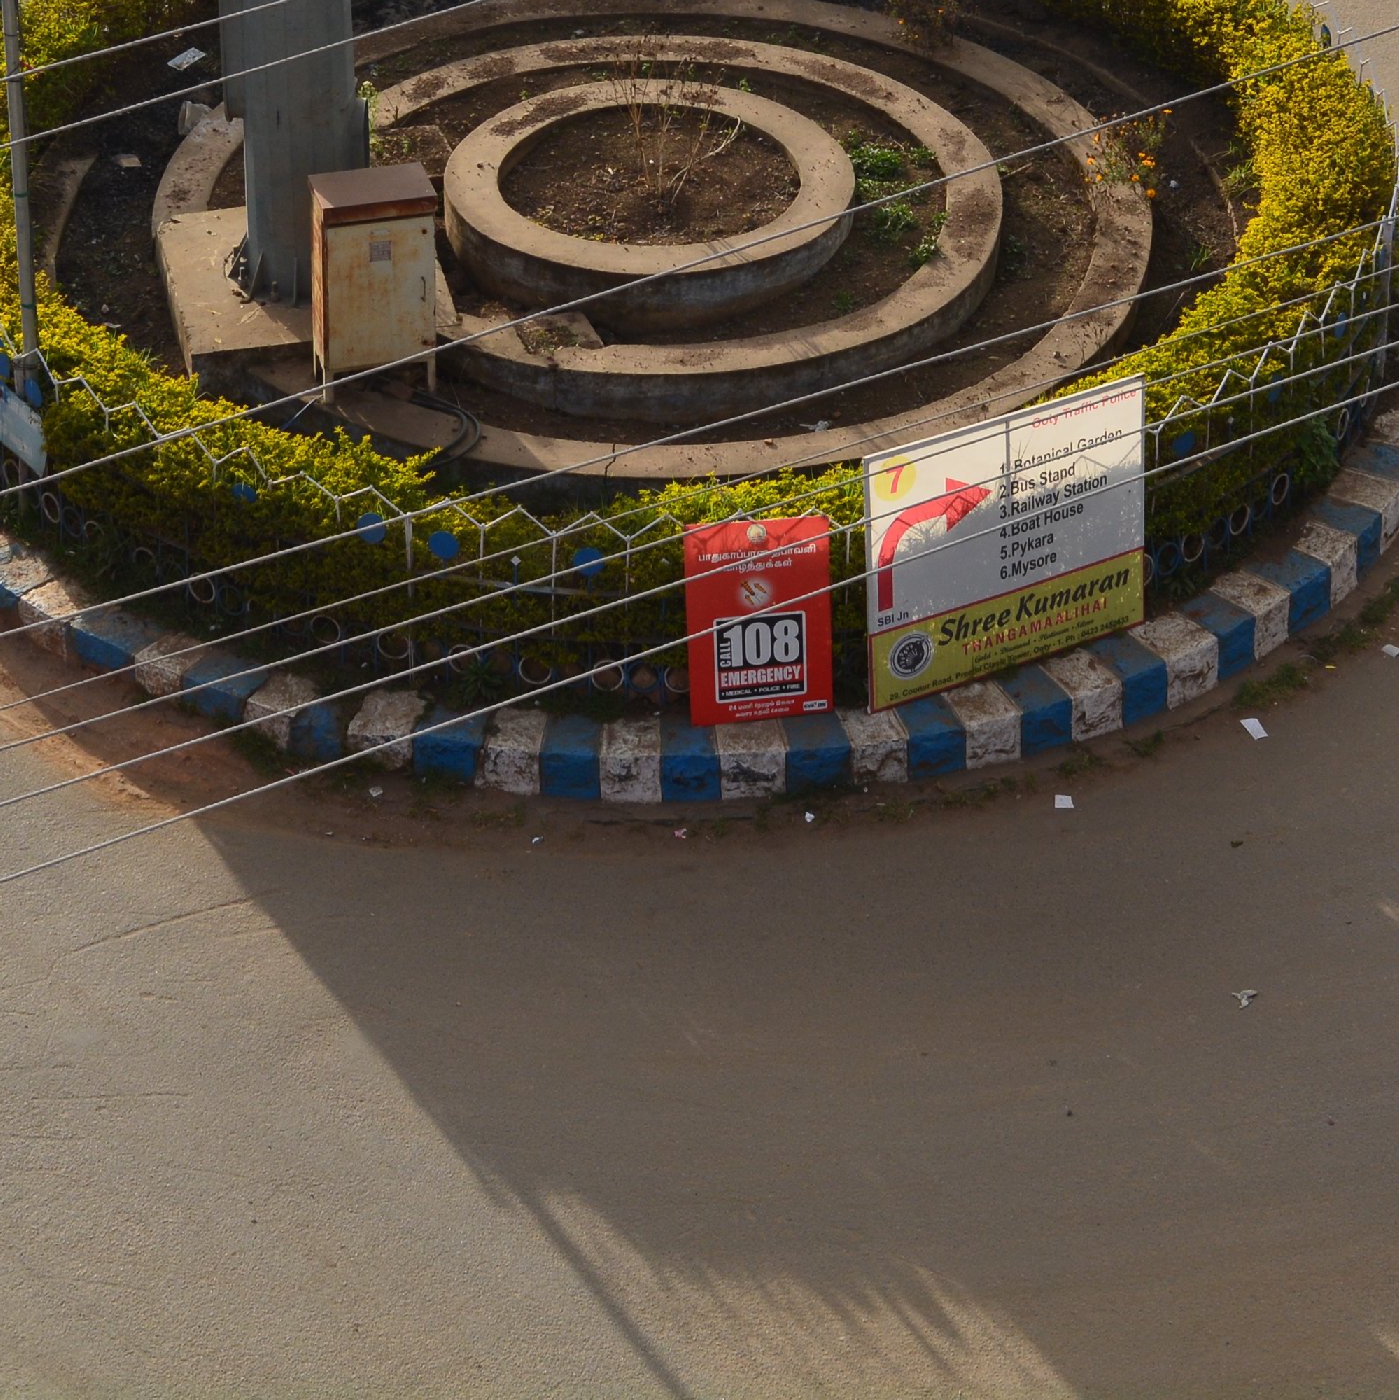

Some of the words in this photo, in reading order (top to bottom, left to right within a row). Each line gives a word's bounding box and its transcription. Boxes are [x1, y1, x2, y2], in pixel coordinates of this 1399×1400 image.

[1063, 401, 1098, 419] Traffic
[1102, 389, 1137, 407] Police
[1077, 429, 1123, 451] Garden
[886, 465, 904, 494] 7
[1039, 462, 1076, 486] Stand
[1063, 475, 1108, 498] Station
[1043, 503, 1084, 525] House
[939, 608, 1011, 645] Shree
[1015, 568, 1130, 622] Kumaran
[877, 613, 895, 627] SBI
[896, 611, 909, 622] Jn
[719, 641, 732, 668] CALL
[723, 619, 800, 667] 108
[720, 665, 802, 687] EMERGENCY
[726, 688, 752, 697] MEDICAL
[758, 685, 781, 693] POLICE
